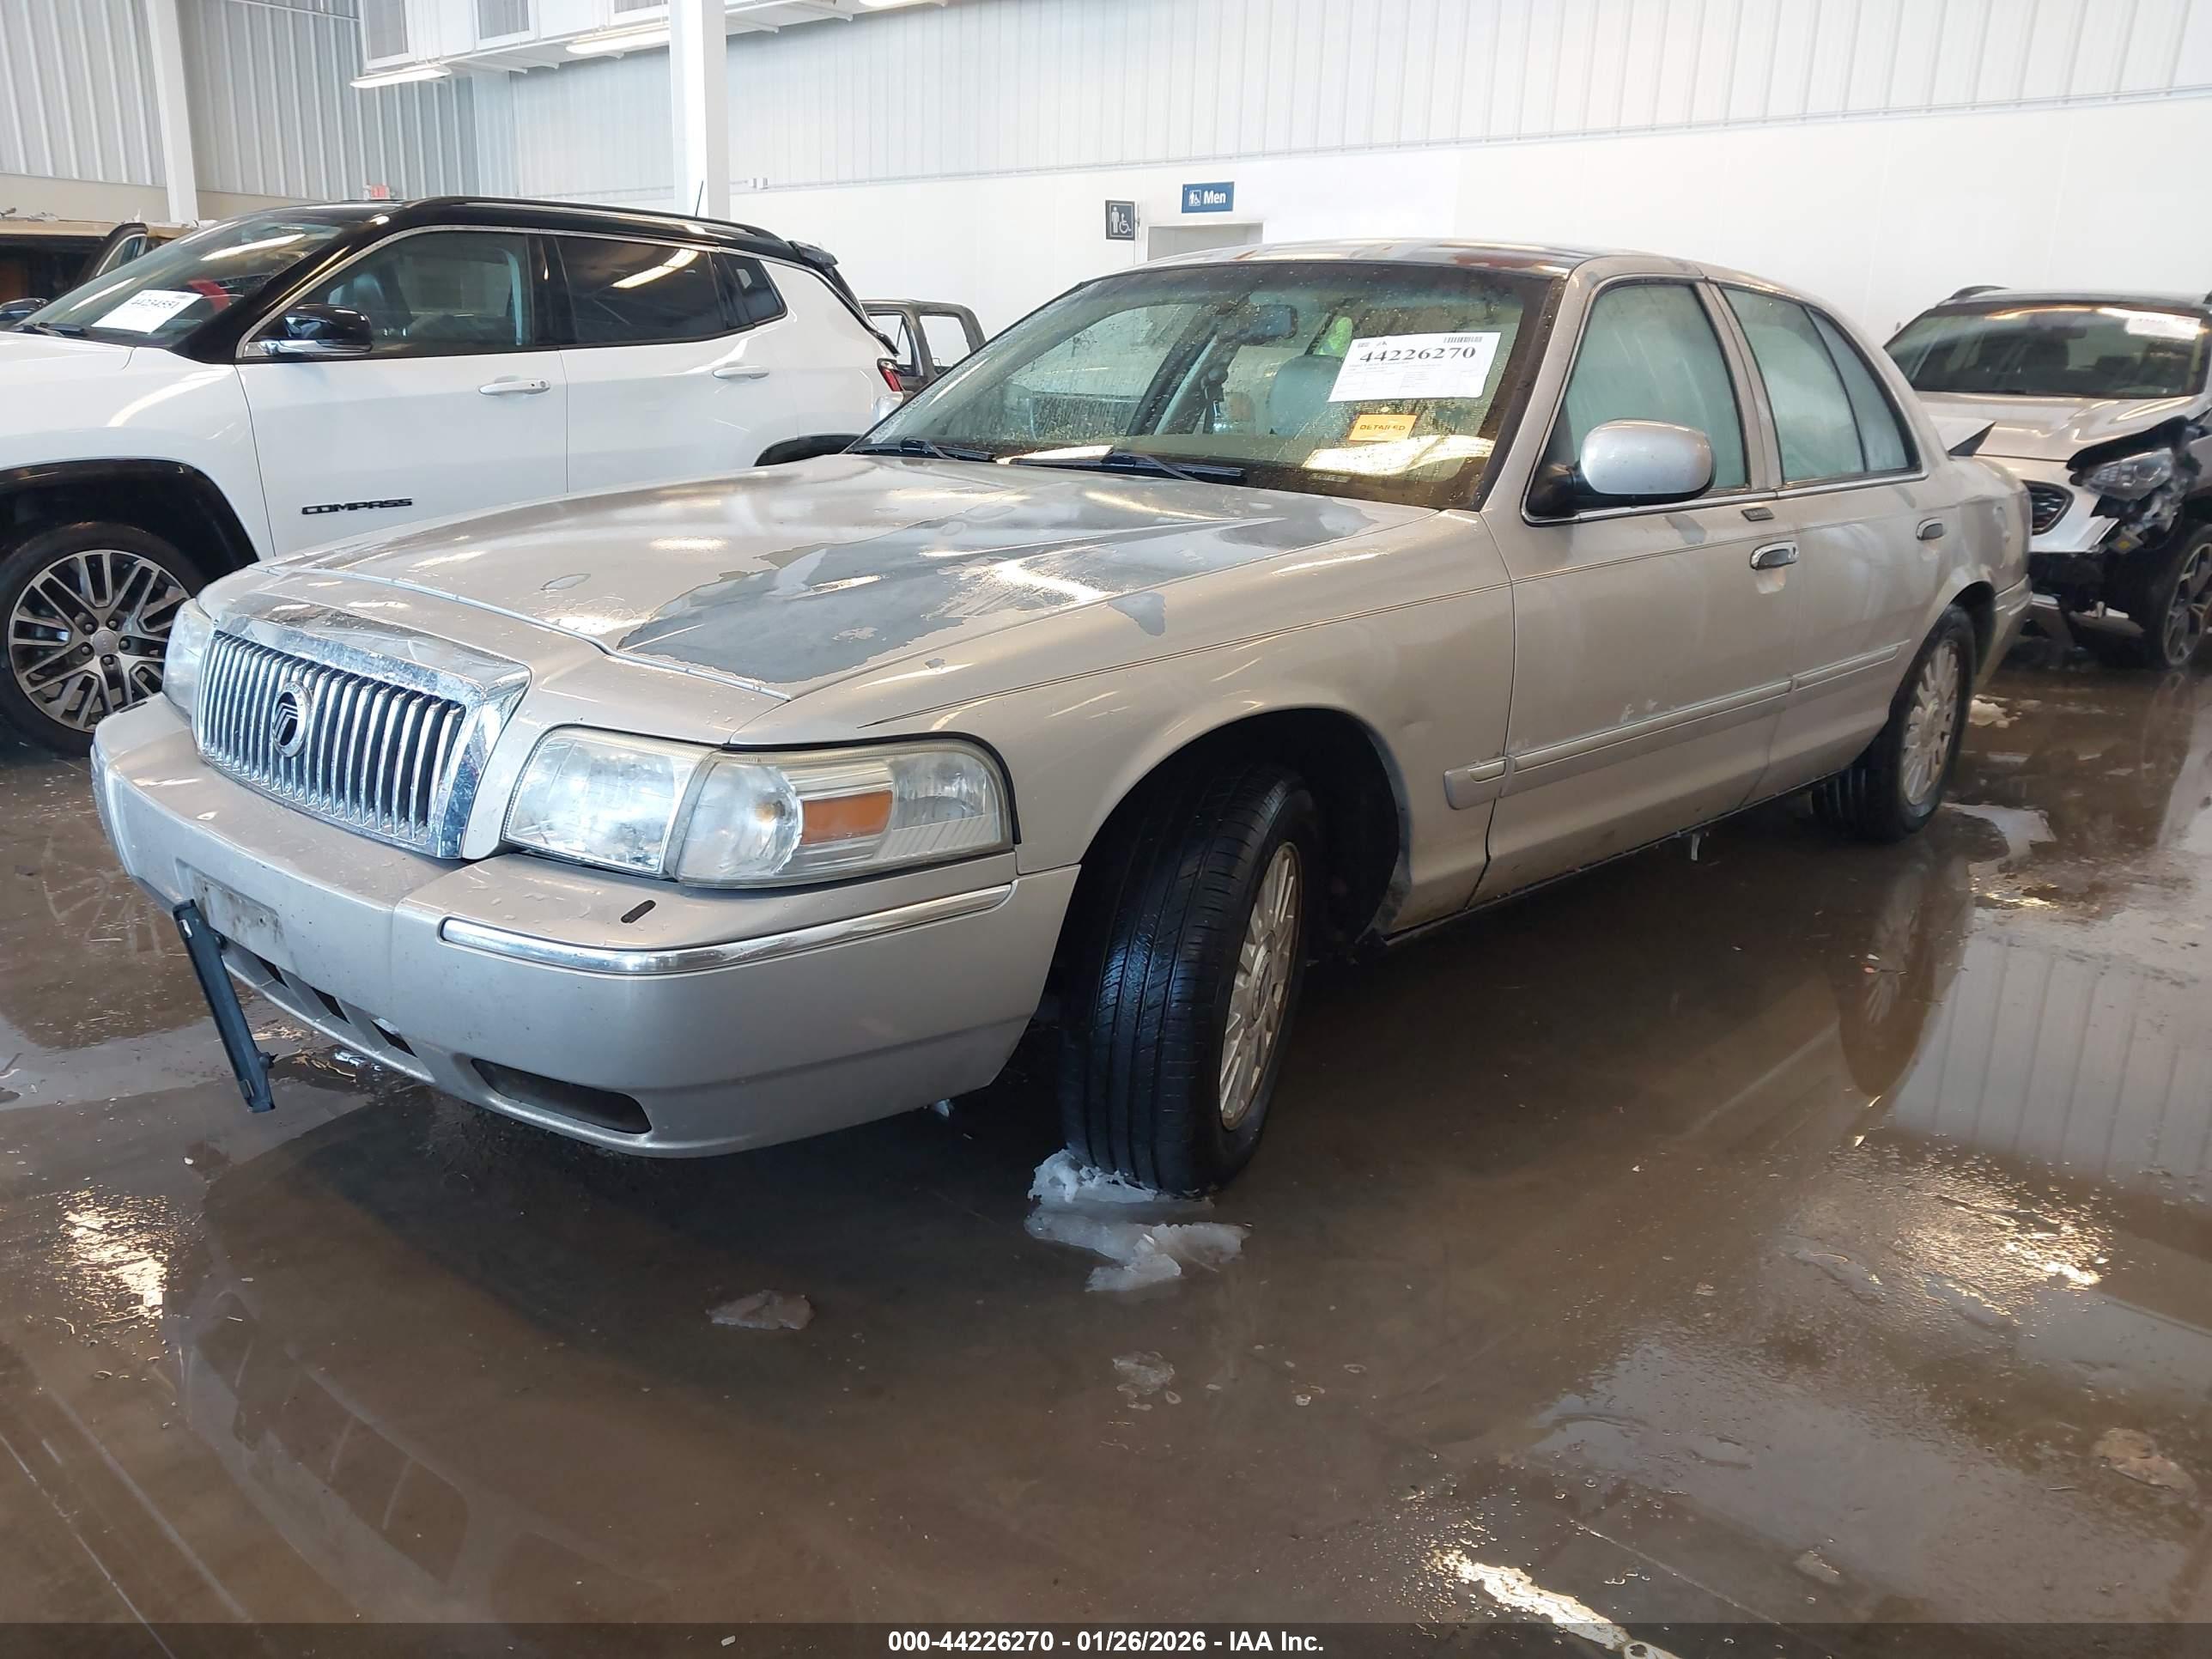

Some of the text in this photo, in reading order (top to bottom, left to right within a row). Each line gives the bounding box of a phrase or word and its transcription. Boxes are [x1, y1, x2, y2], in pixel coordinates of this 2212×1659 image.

[1204, 190, 1226, 204] Men
[1359, 347, 1476, 362] 44226270
[302, 498, 412, 514] COMPASS
